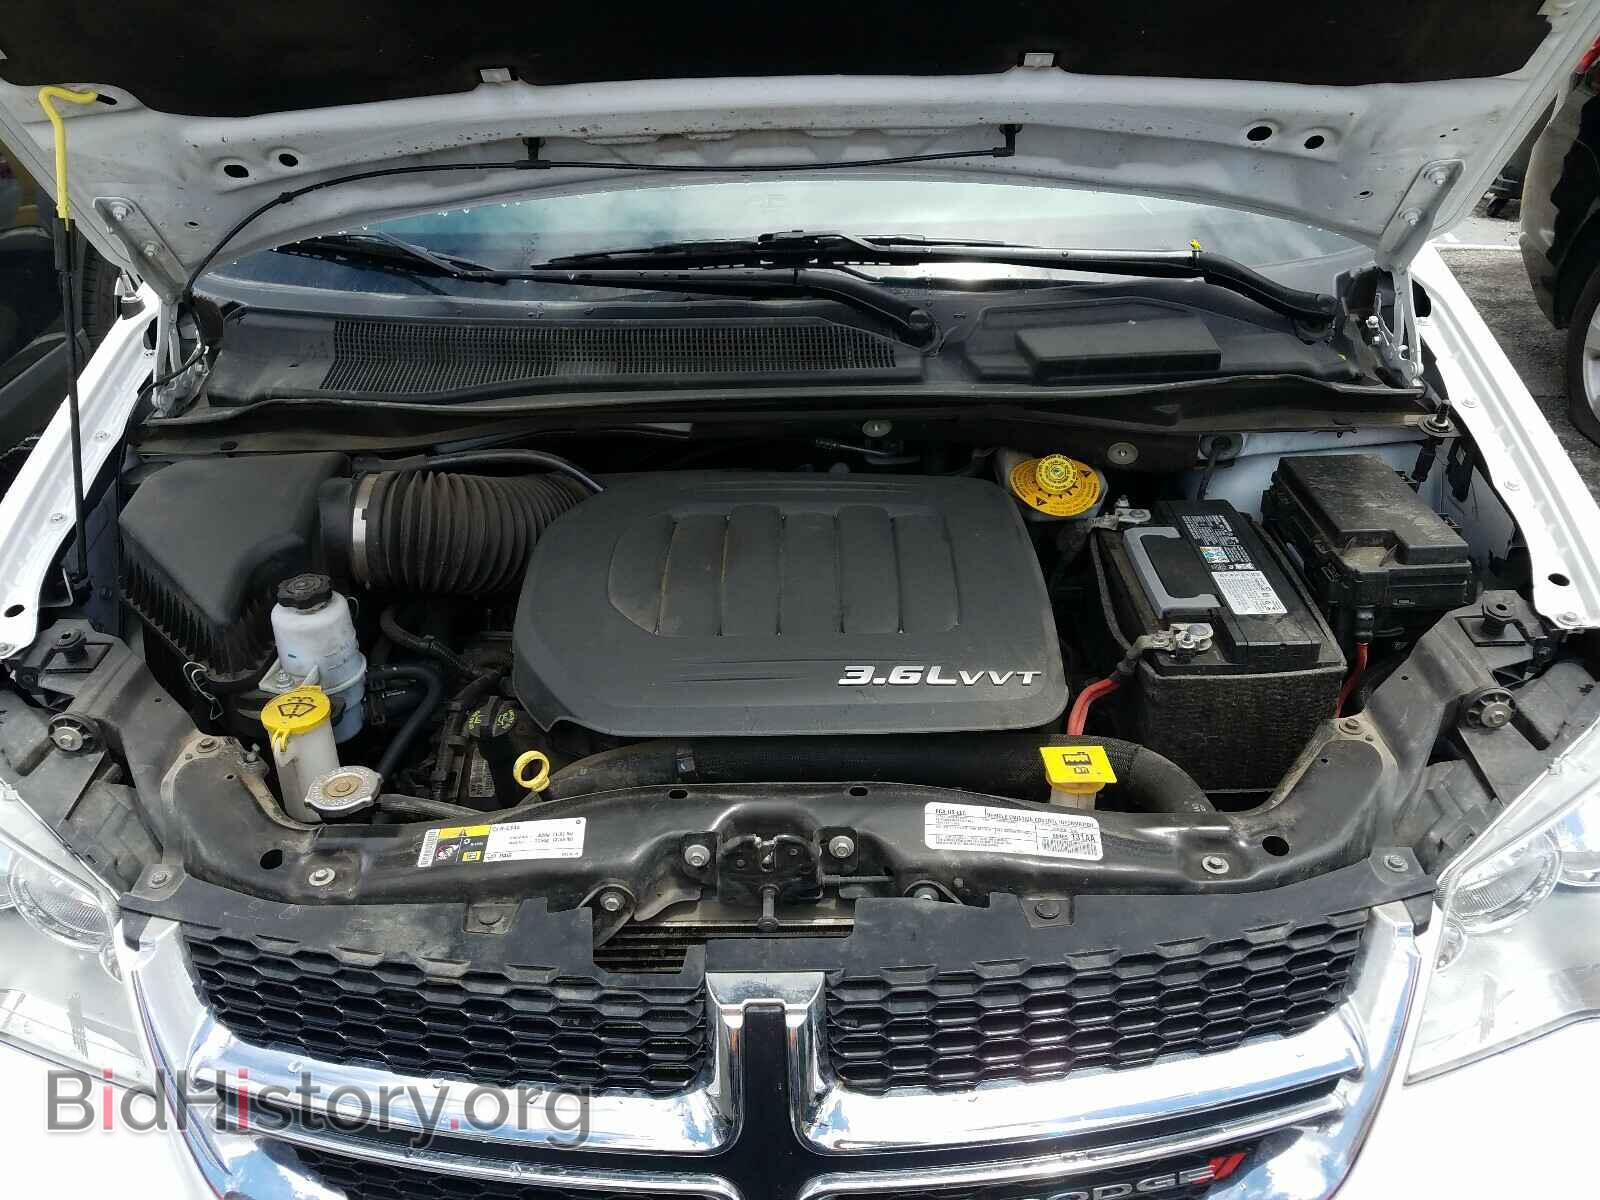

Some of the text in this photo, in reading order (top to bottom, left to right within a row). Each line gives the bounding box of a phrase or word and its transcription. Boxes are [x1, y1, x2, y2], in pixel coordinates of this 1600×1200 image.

[838, 665, 1042, 686] 3.6L VVT
[1023, 1165, 1215, 1200] ODGE
